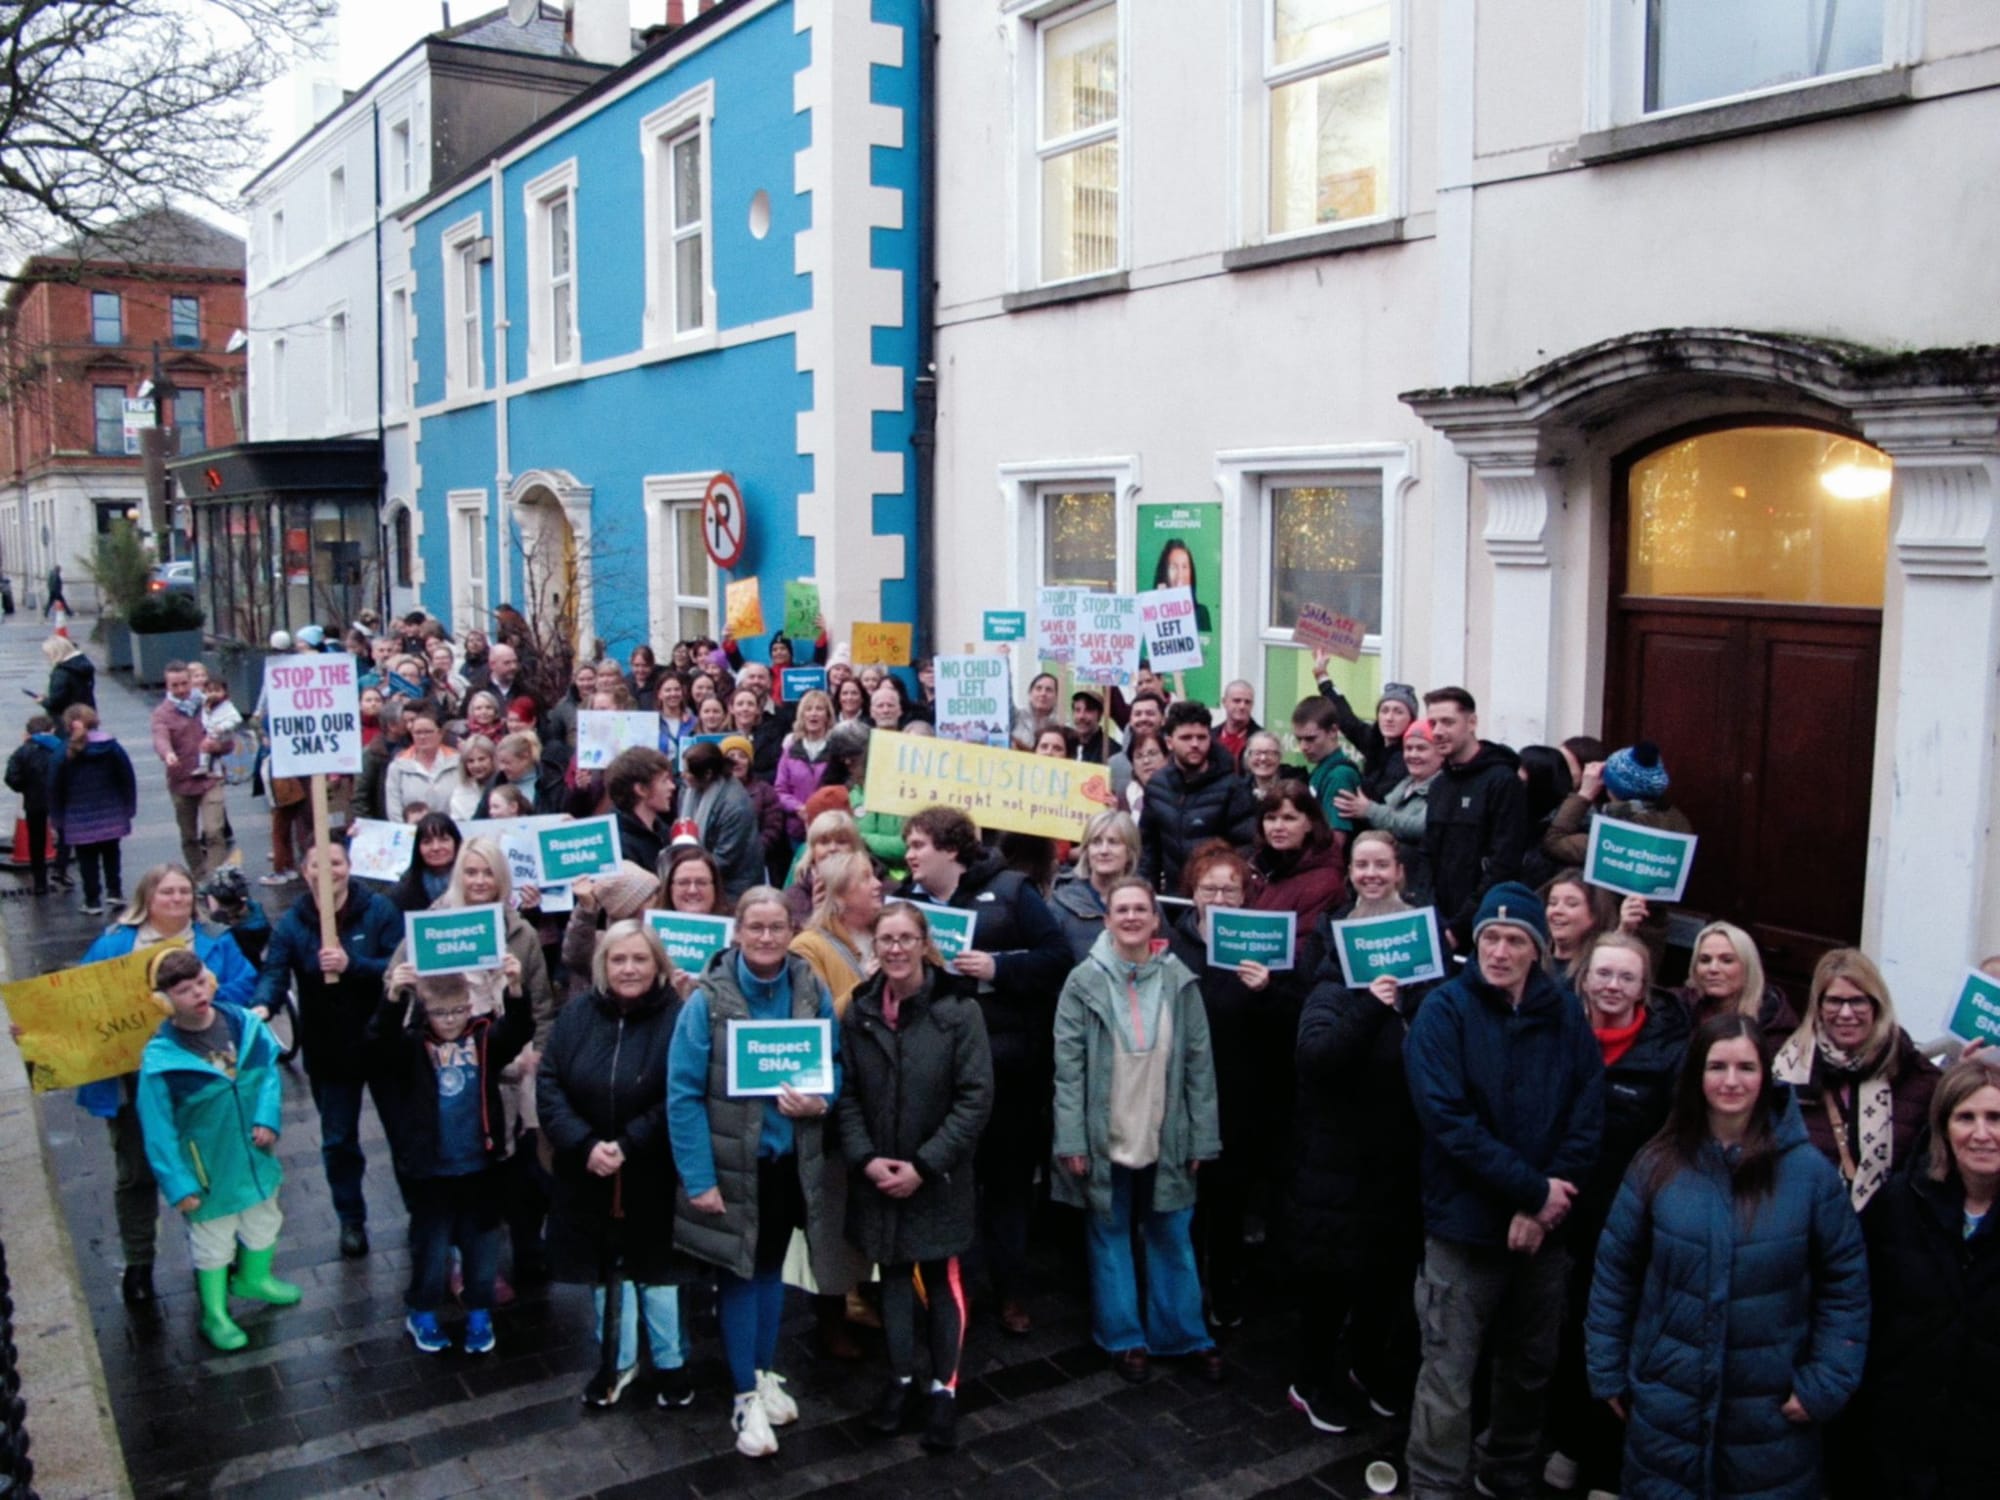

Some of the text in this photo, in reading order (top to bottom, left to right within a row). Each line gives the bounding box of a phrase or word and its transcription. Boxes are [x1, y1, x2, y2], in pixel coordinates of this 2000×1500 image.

[1082, 597, 1134, 614] STOP THE
[1142, 600, 1192, 622] NO CHILD
[1094, 615, 1121, 630] CUTS
[1156, 619, 1181, 638] LEFT
[1080, 634, 1135, 650] SAVE OUR
[1151, 637, 1194, 656] BEHIND
[1089, 651, 1124, 666] SNA'S
[272, 664, 350, 689] STOP THE
[941, 660, 1001, 677] NO CHILD
[958, 679, 985, 697] LEFT
[293, 688, 333, 711] CUTS
[948, 697, 996, 716] BEHIND
[273, 713, 355, 737] FUND OUR
[292, 734, 339, 756] SNA'S
[898, 744, 1070, 801] INCLUSION
[900, 781, 917, 799] is
[929, 790, 938, 800] a
[949, 791, 991, 812] right
[1002, 800, 1023, 811] not
[549, 834, 604, 852] Respect
[1602, 839, 1678, 865] Our schools
[561, 850, 598, 865] SNAs
[1602, 857, 1671, 879] need SNAs
[424, 923, 486, 940] Respect
[660, 927, 716, 945] Respect
[1217, 926, 1283, 940] Our schools
[1354, 930, 1418, 951] Respect
[436, 941, 477, 955] SNAs
[667, 944, 705, 960] SNAs
[1220, 941, 1280, 952] need SNAs
[1368, 950, 1411, 968] SNAs
[747, 1040, 811, 1056] Respect
[758, 1058, 801, 1072] SNAs
